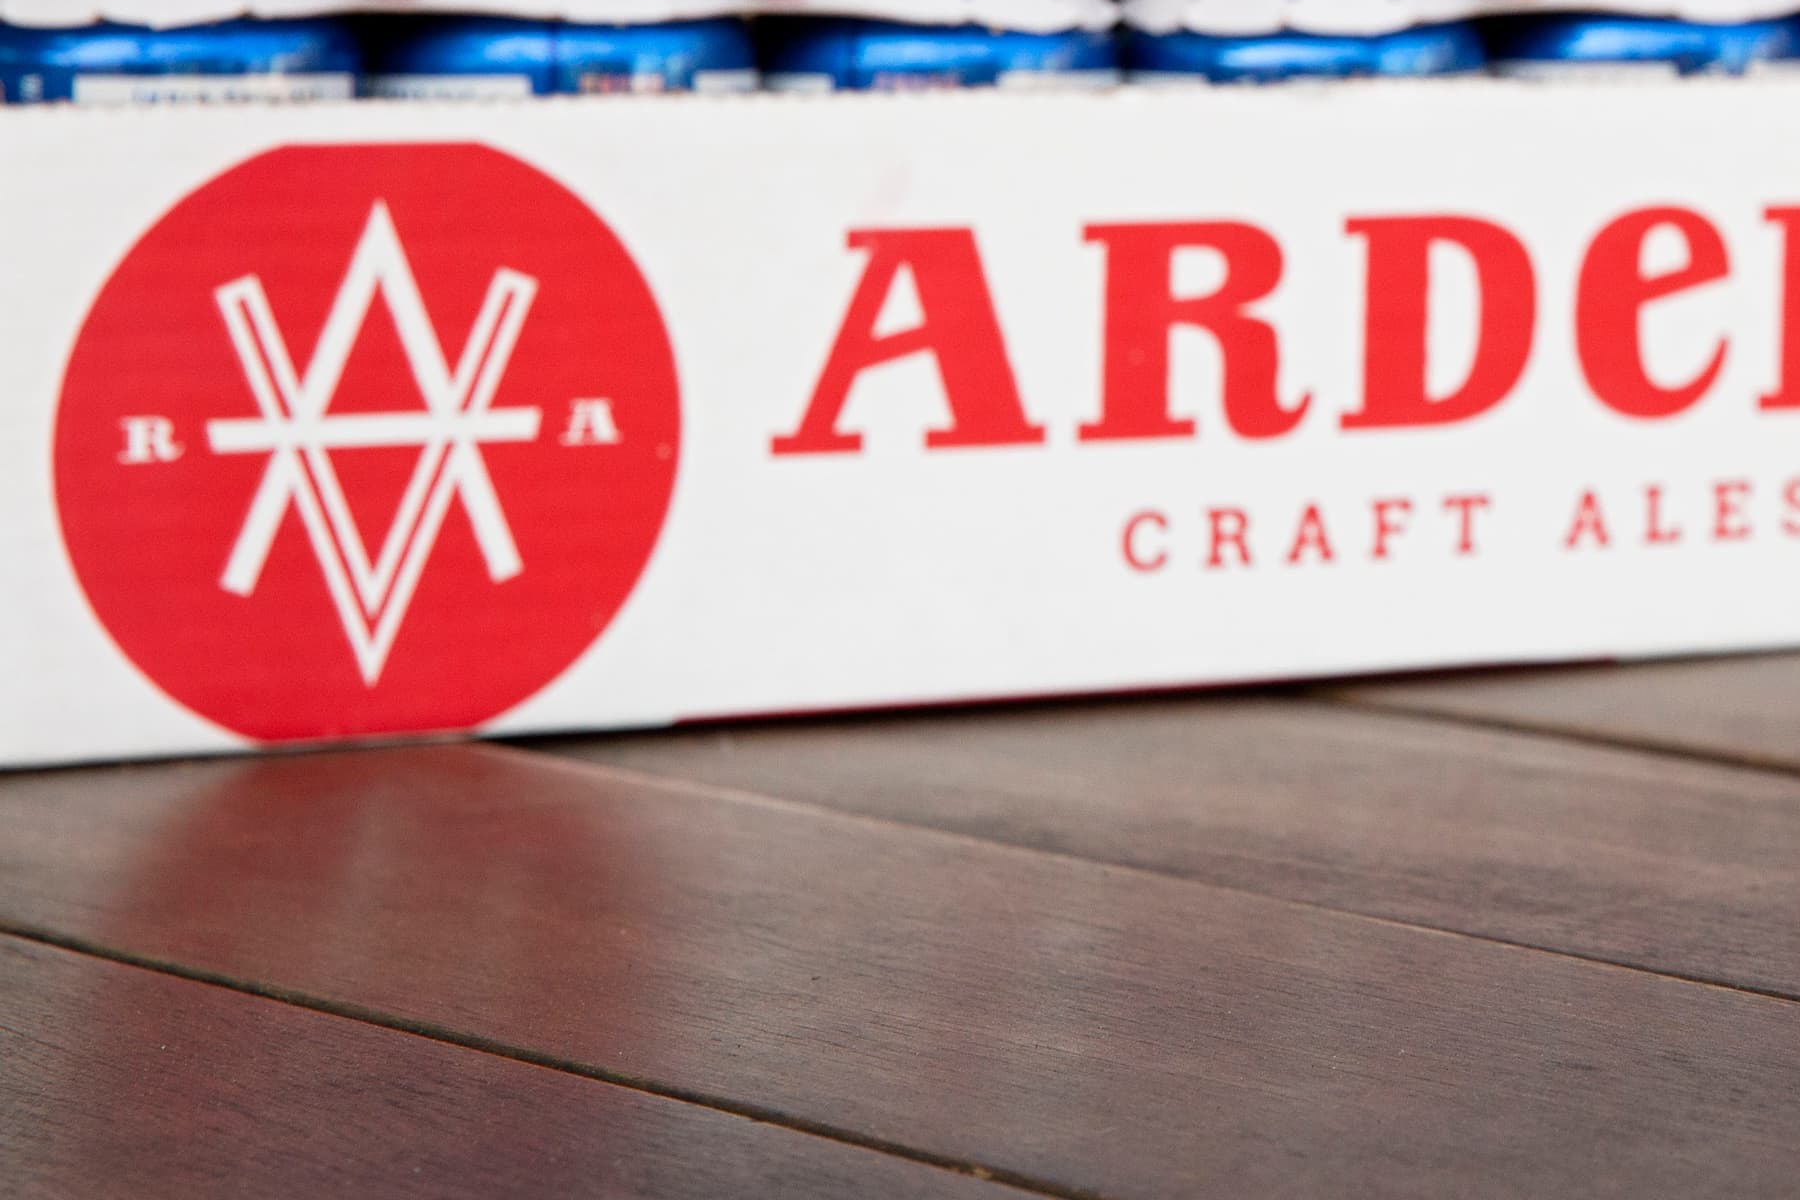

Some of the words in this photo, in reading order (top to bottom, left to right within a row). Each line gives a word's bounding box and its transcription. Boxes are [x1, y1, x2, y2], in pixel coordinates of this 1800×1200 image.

[116, 414, 184, 465] R
[559, 398, 622, 447] A
[1120, 493, 1491, 573] CRAFT
